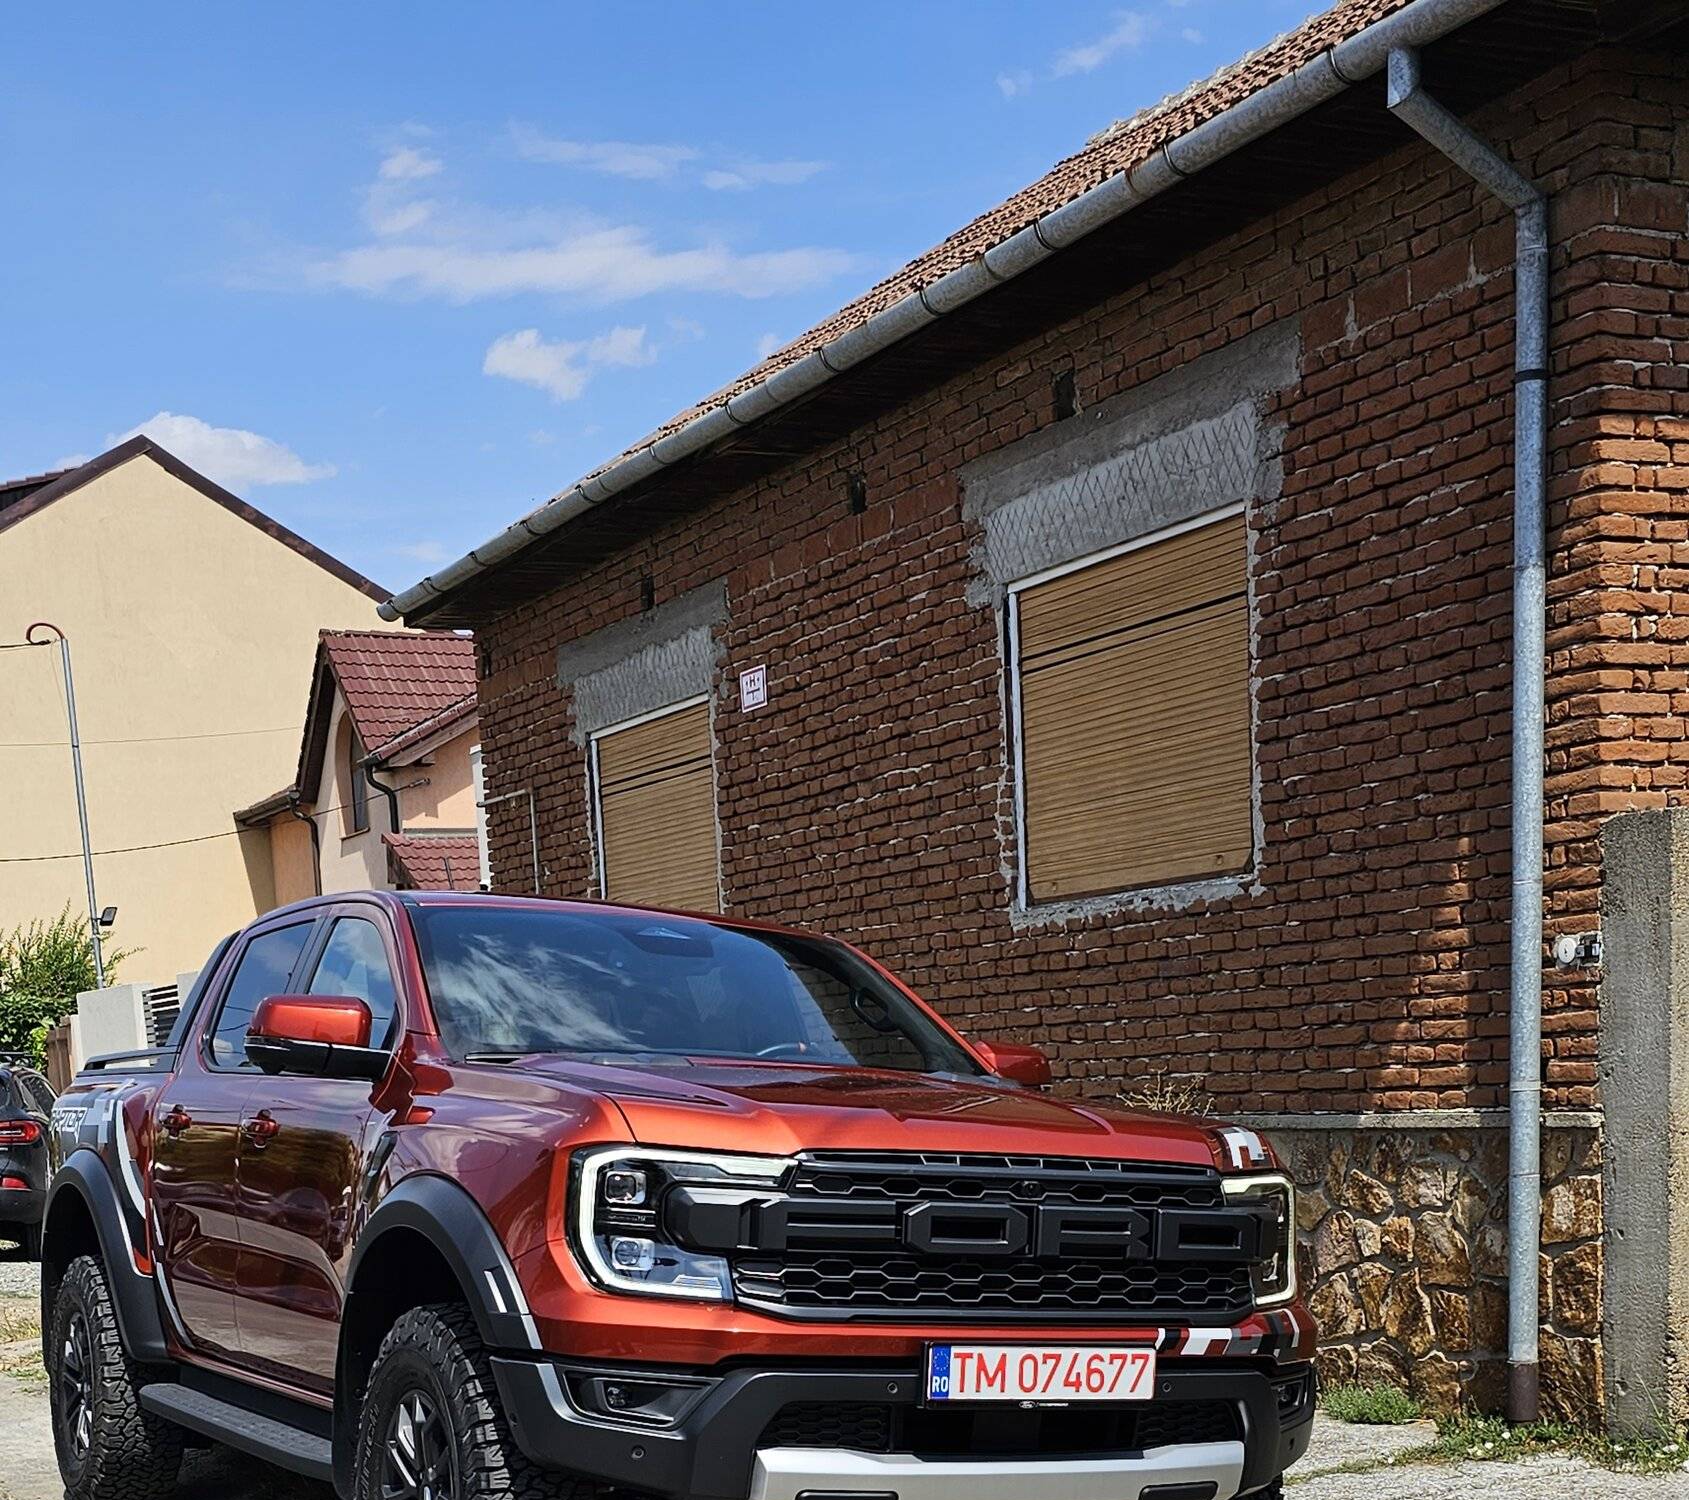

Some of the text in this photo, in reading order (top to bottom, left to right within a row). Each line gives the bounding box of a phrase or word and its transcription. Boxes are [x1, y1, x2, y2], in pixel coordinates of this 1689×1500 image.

[762, 1200, 1258, 1261] FORD
[932, 1376, 949, 1393] RO
[954, 1352, 1150, 1393] TM 074677
